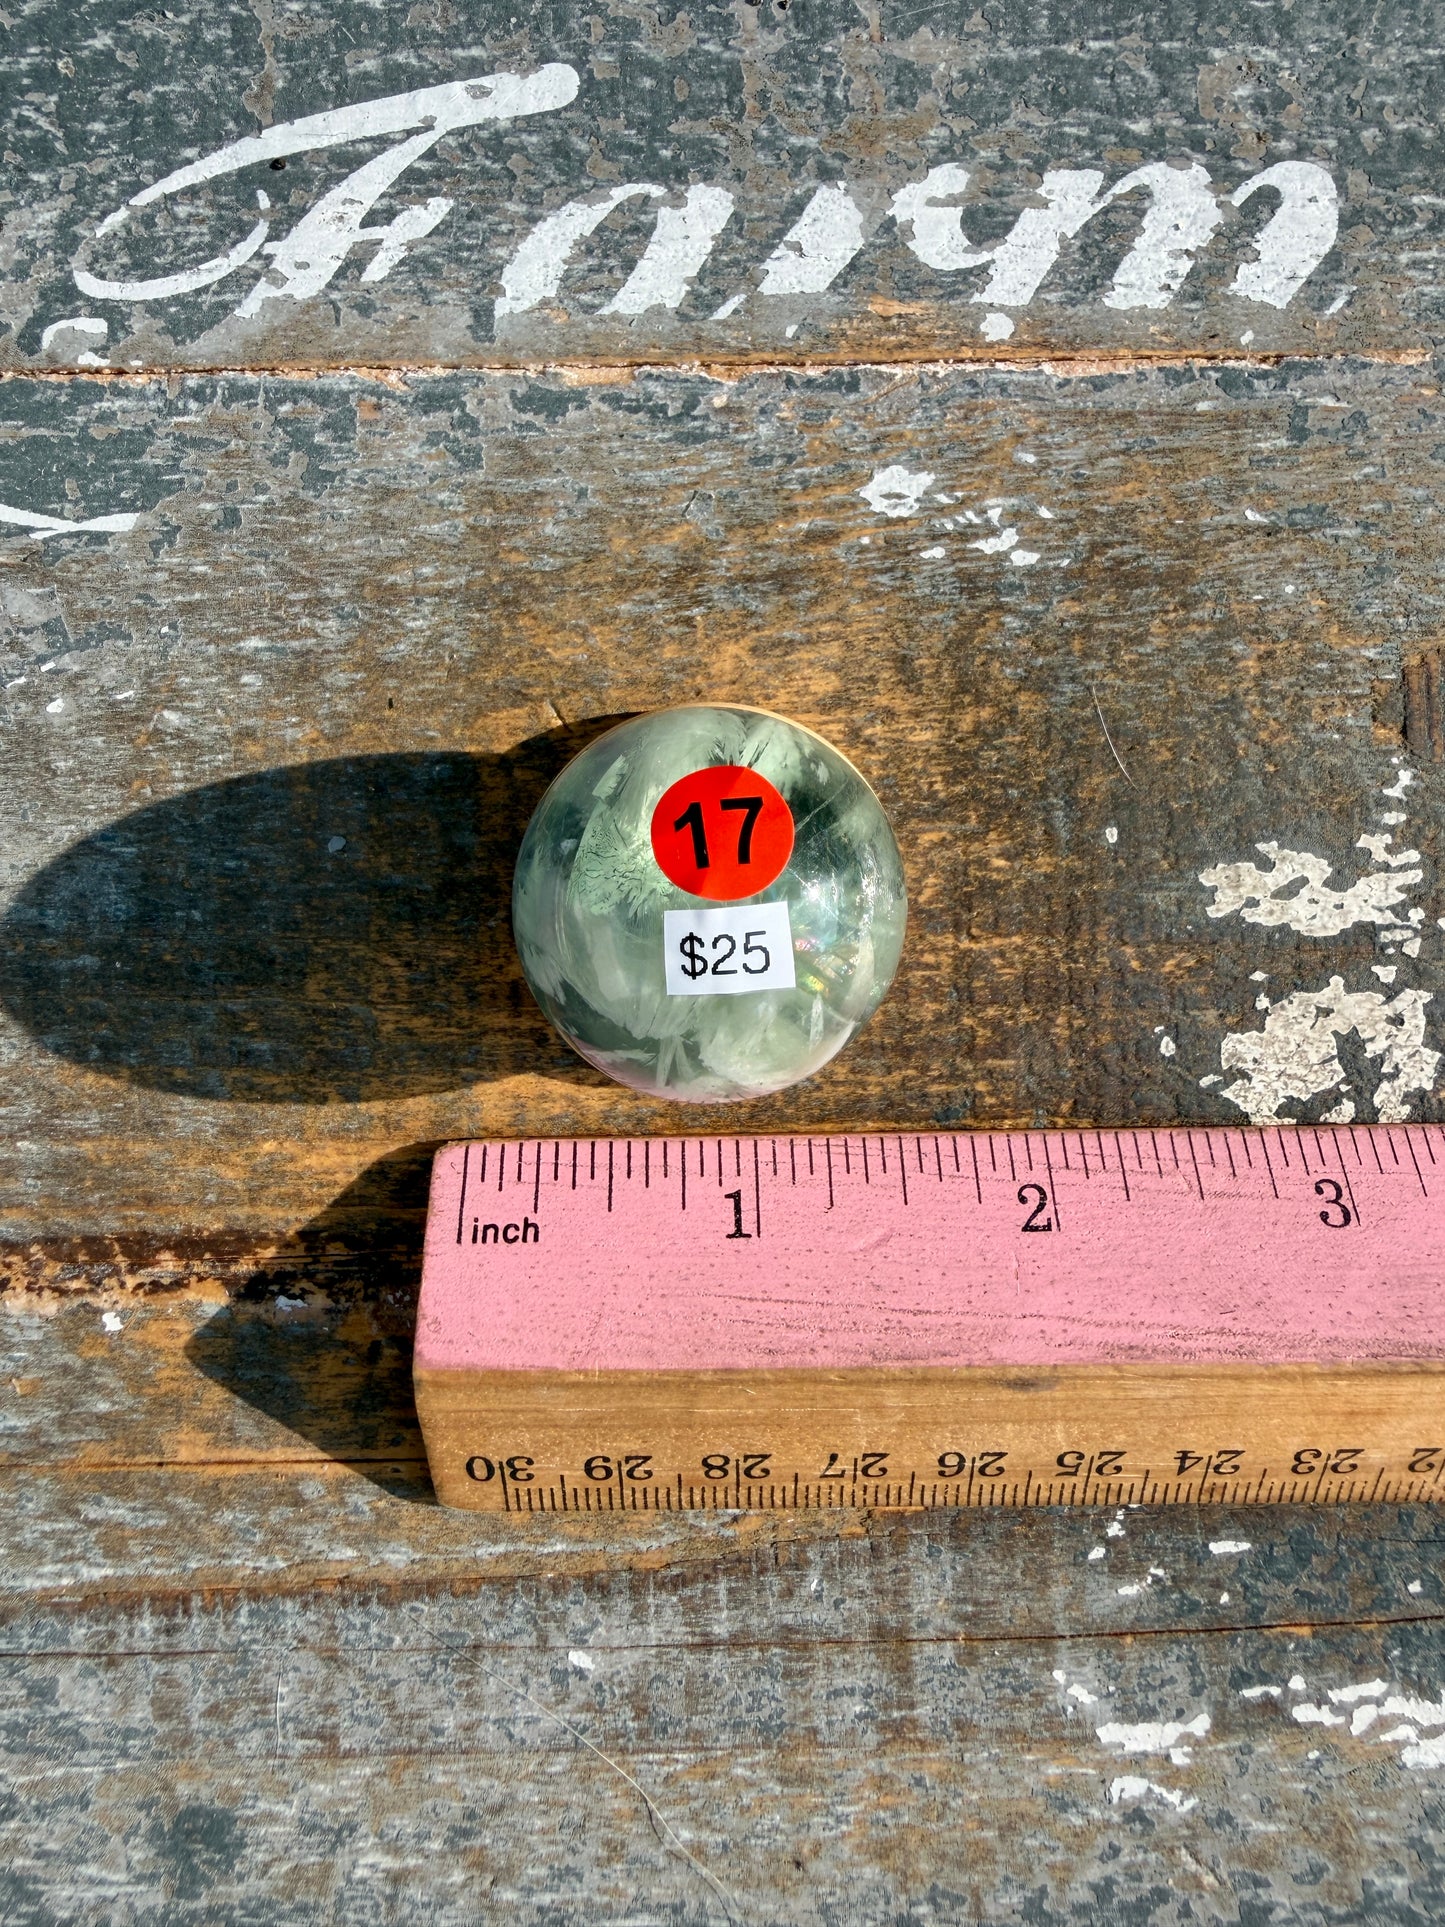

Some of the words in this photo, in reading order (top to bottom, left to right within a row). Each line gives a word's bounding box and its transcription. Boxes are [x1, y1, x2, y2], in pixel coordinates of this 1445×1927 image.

[673, 796, 764, 870] 17
[679, 930, 771, 981] $25
[471, 1217, 540, 1245] inch
[723, 1189, 753, 1240] 1
[1017, 1183, 1053, 1233] 2
[1314, 1178, 1352, 1229] 3
[465, 1455, 535, 1482] 30
[583, 1454, 654, 1481] 29
[701, 1453, 772, 1480] 28
[820, 1452, 890, 1480] 27
[937, 1451, 1009, 1479] 26
[1055, 1450, 1127, 1478] 25
[1173, 1449, 1247, 1476] 24
[1291, 1448, 1365, 1475] 23
